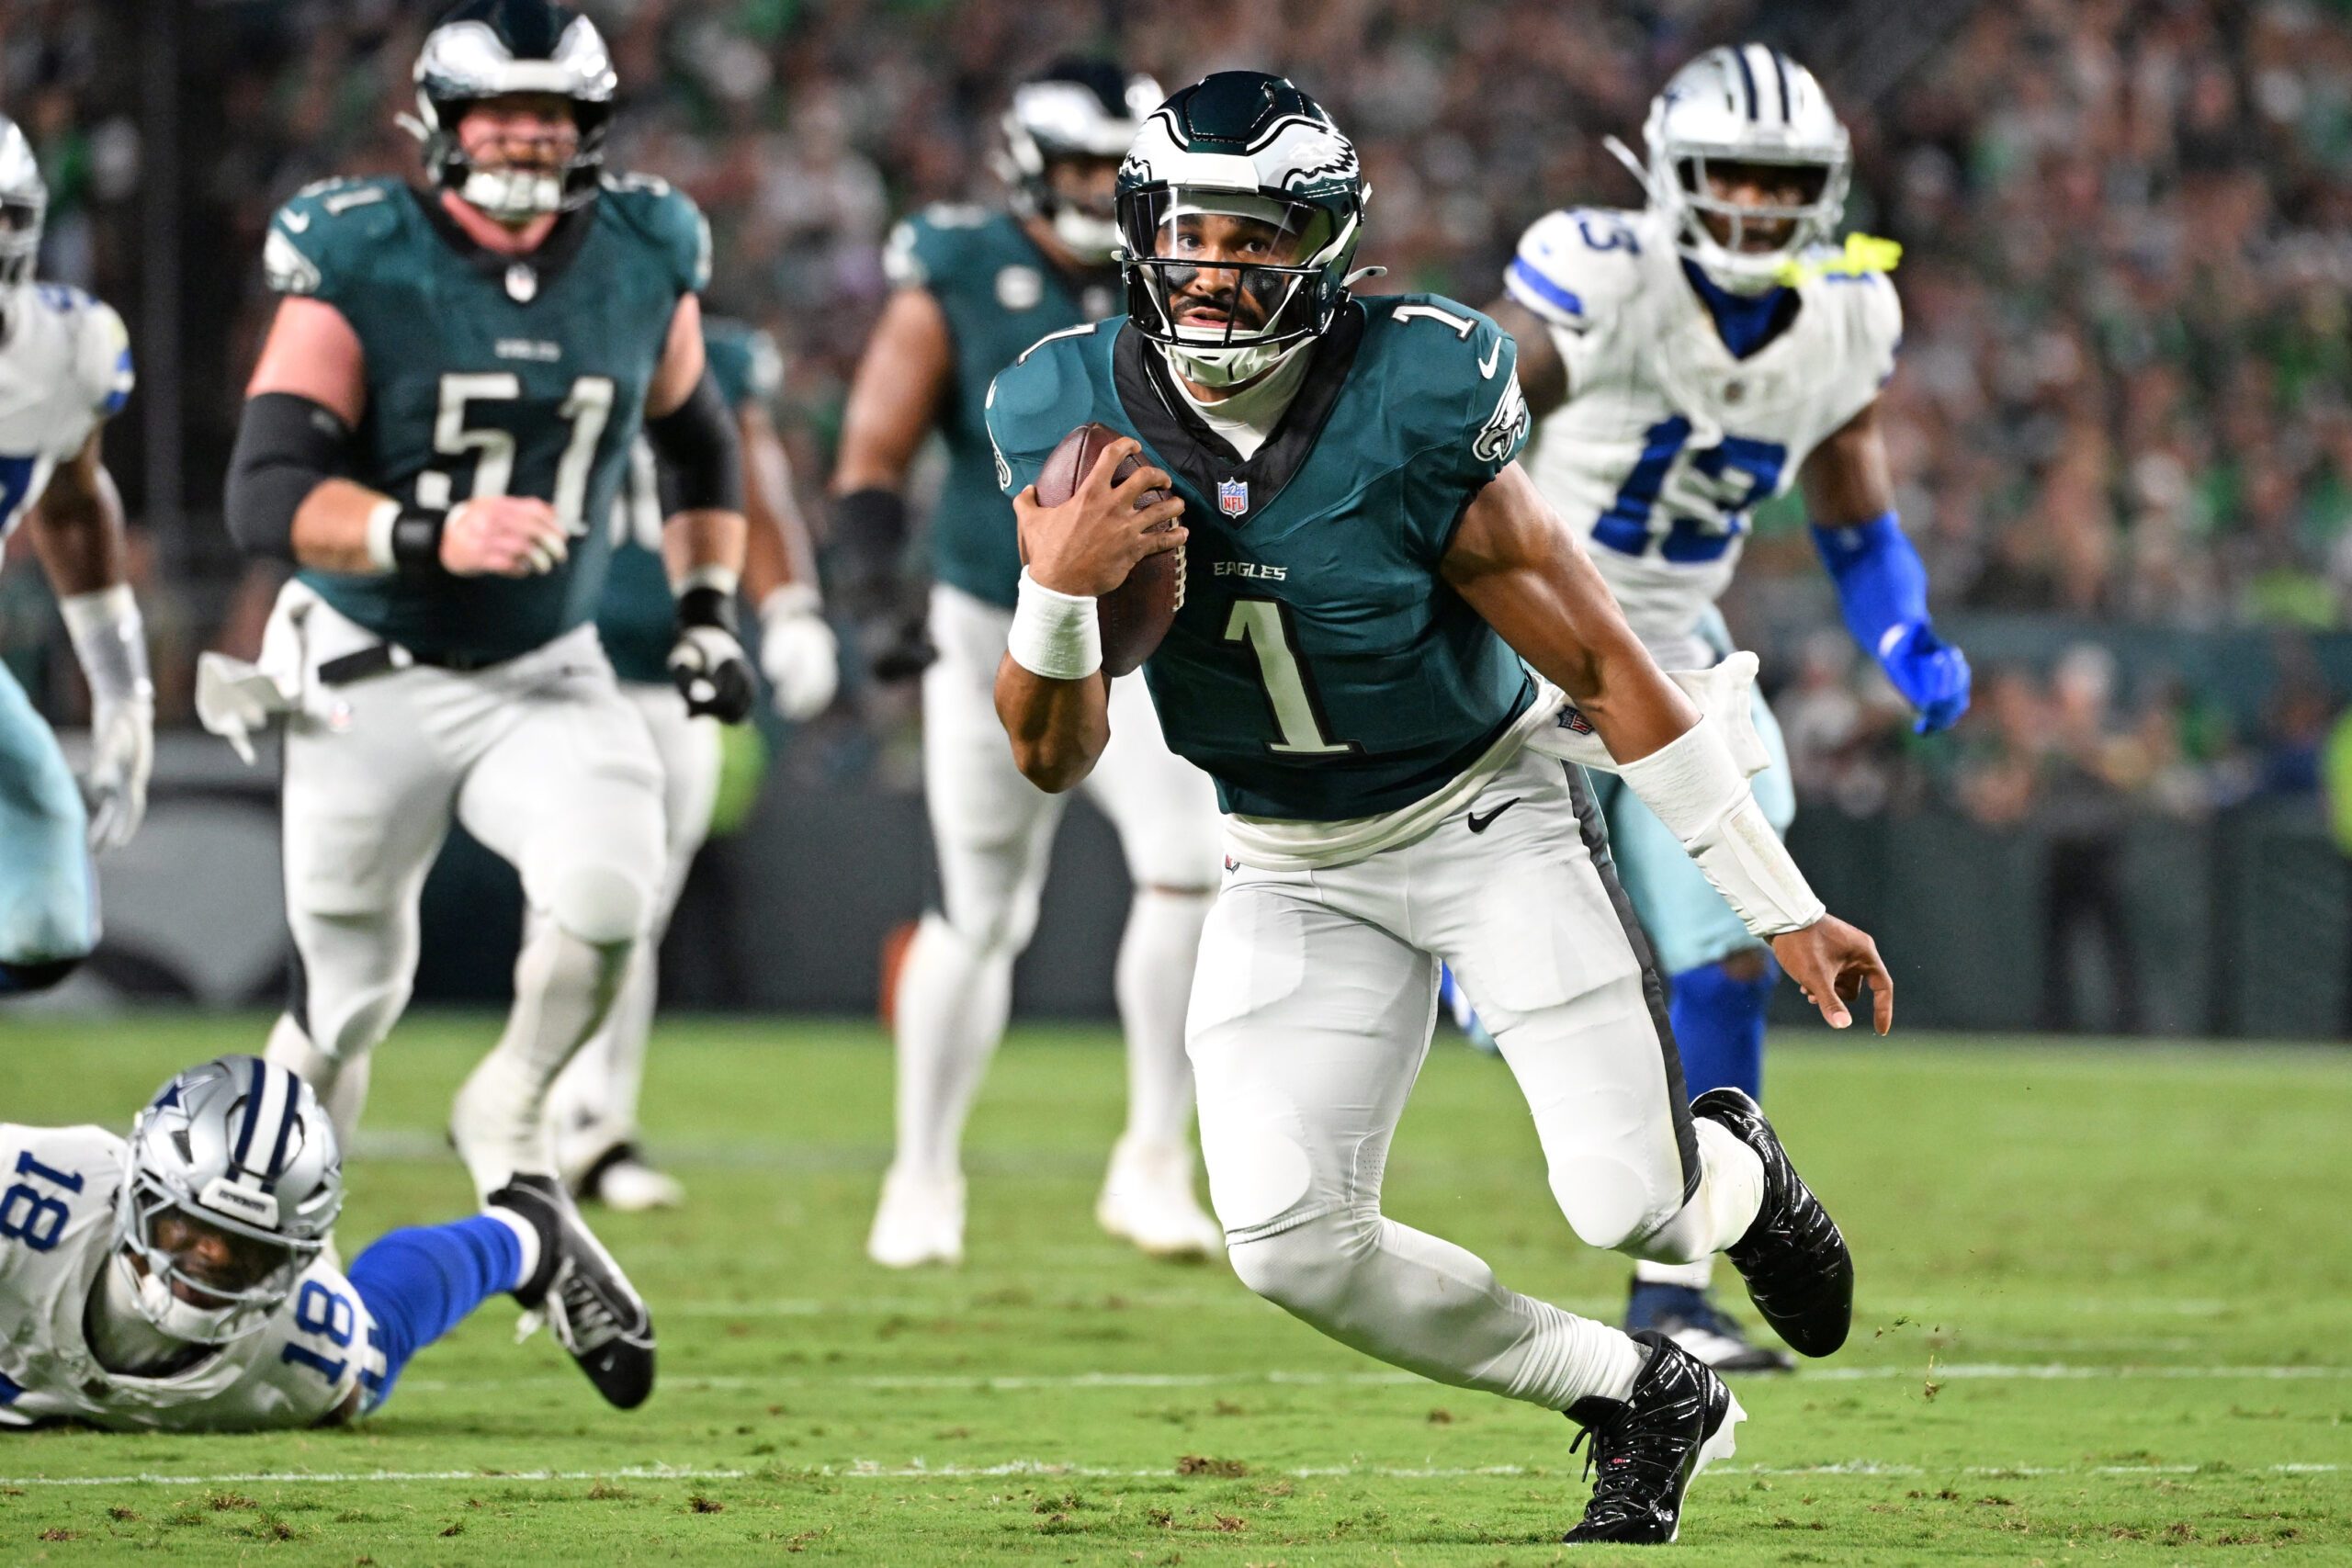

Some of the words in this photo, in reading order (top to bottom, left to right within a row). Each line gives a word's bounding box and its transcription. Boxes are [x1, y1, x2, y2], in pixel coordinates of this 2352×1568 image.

[1391, 305, 1478, 340] 1
[415, 372, 615, 536] 51
[1223, 497, 1244, 511] NFL
[1591, 413, 1788, 564] 13
[1213, 561, 1288, 581] EAGLES
[1224, 599, 1351, 753] 1
[0, 1149, 85, 1254] 18
[279, 1280, 355, 1388] 18
